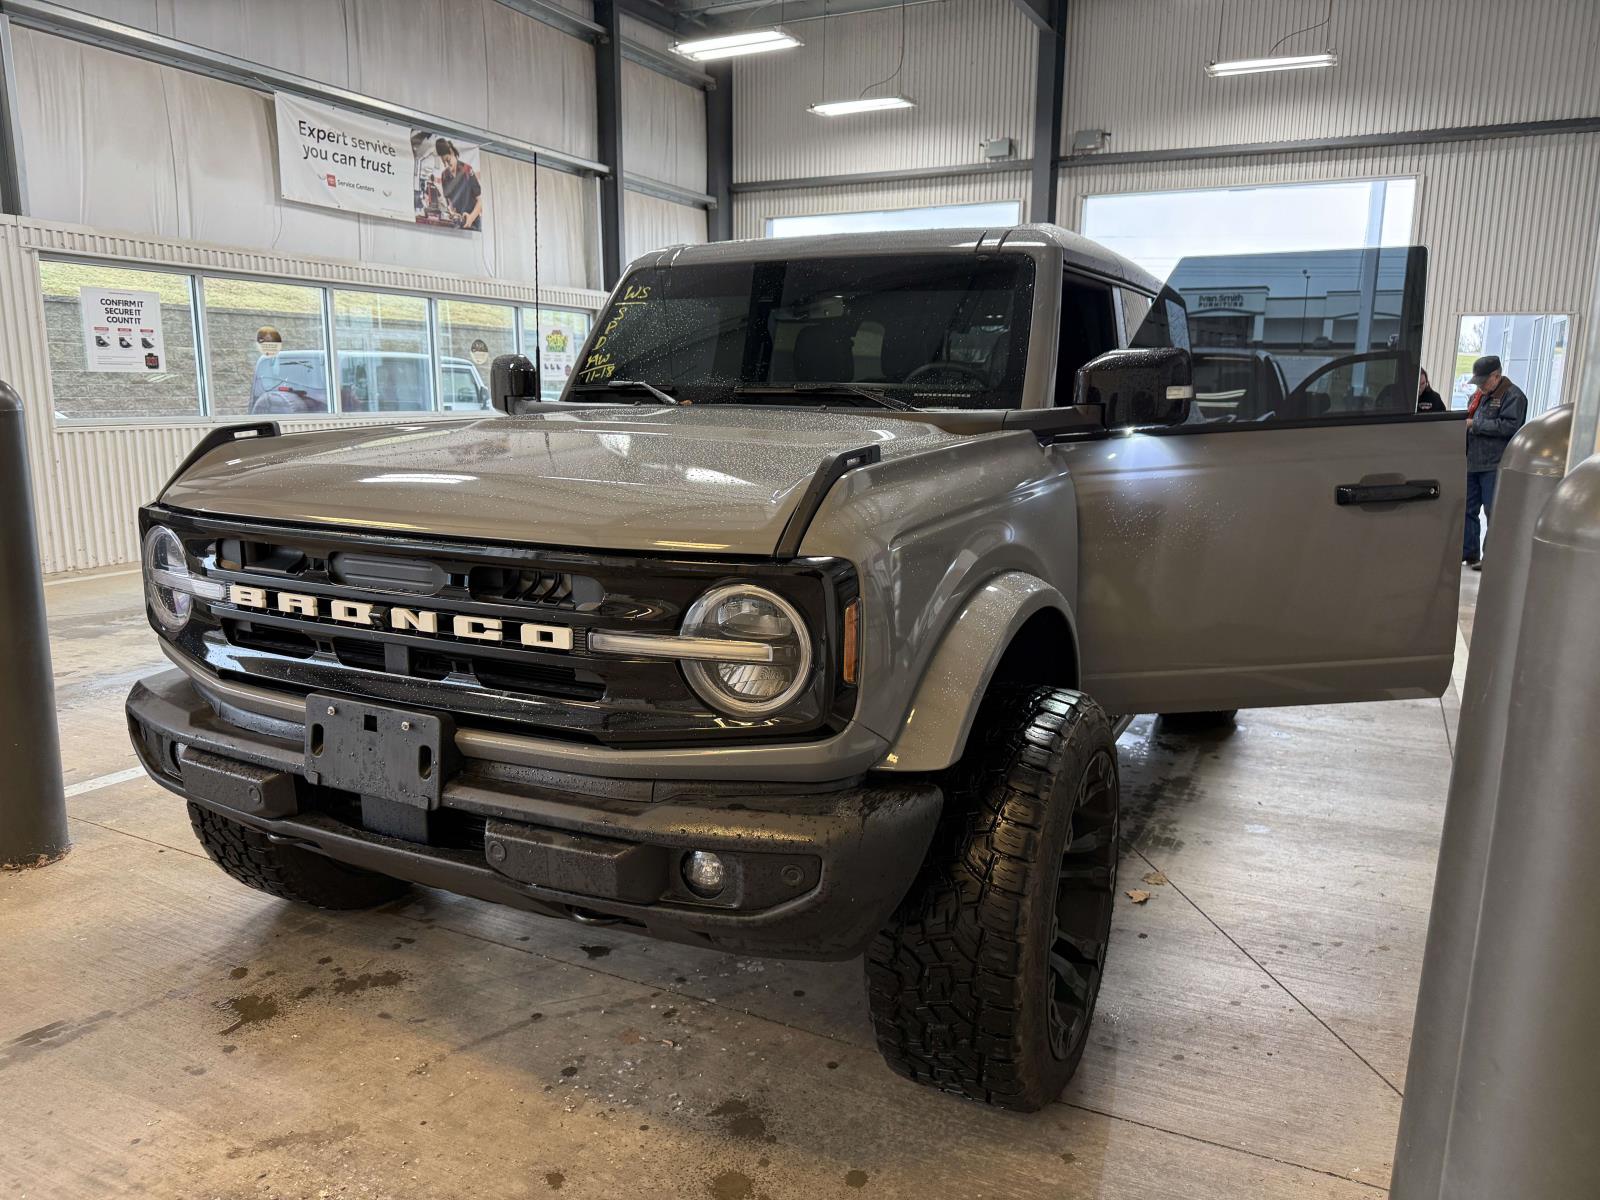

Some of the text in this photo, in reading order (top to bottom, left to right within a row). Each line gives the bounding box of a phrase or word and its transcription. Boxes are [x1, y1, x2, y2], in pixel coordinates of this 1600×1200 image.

[298, 120, 396, 157] Expert service
[303, 145, 395, 175] you can trust.
[337, 179, 356, 189] Service
[355, 182, 375, 193] Centers
[100, 298, 136, 307] CONFIRM
[1219, 294, 1244, 302] Smith
[104, 307, 134, 316] SECURE
[106, 316, 141, 325] COUNT IT
[604, 321, 617, 334] P
[592, 336, 606, 350] D
[585, 365, 615, 383] 11-18
[229, 585, 574, 650] BRONCO
